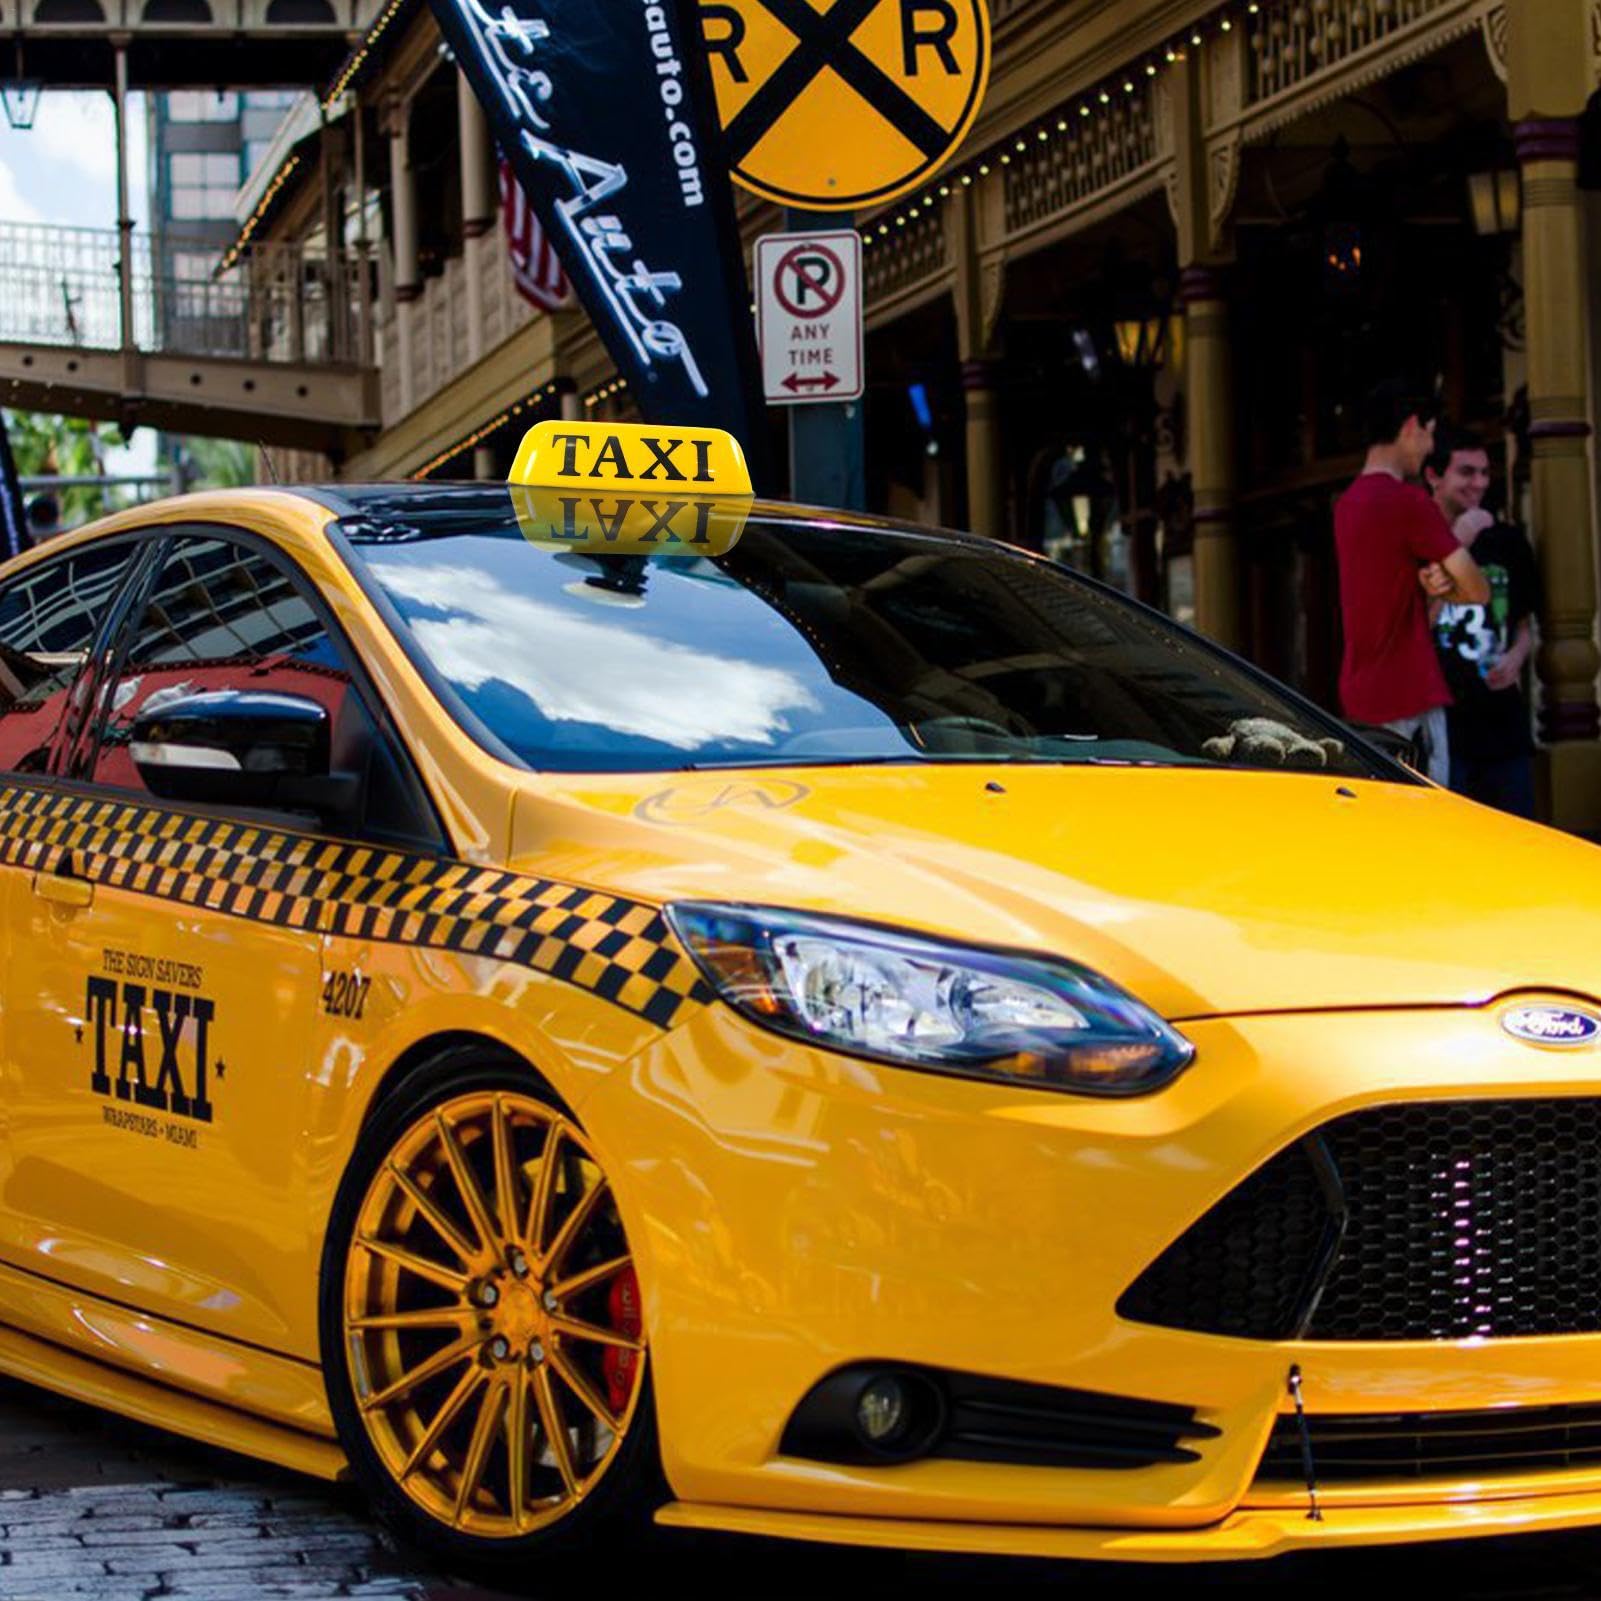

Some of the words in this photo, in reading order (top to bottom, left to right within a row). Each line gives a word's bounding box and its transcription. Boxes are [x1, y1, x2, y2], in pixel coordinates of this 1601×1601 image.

[642, 0, 704, 206] auto.com
[521, 128, 709, 397] Auto
[791, 324, 831, 341] ANY
[788, 349, 833, 366] TIME
[551, 434, 715, 482] TAXI
[103, 949, 125, 973] THE
[126, 953, 155, 978] SIGN
[156, 959, 203, 988] SAVERS
[322, 969, 371, 1020] 4207
[87, 975, 215, 1122] TAXI
